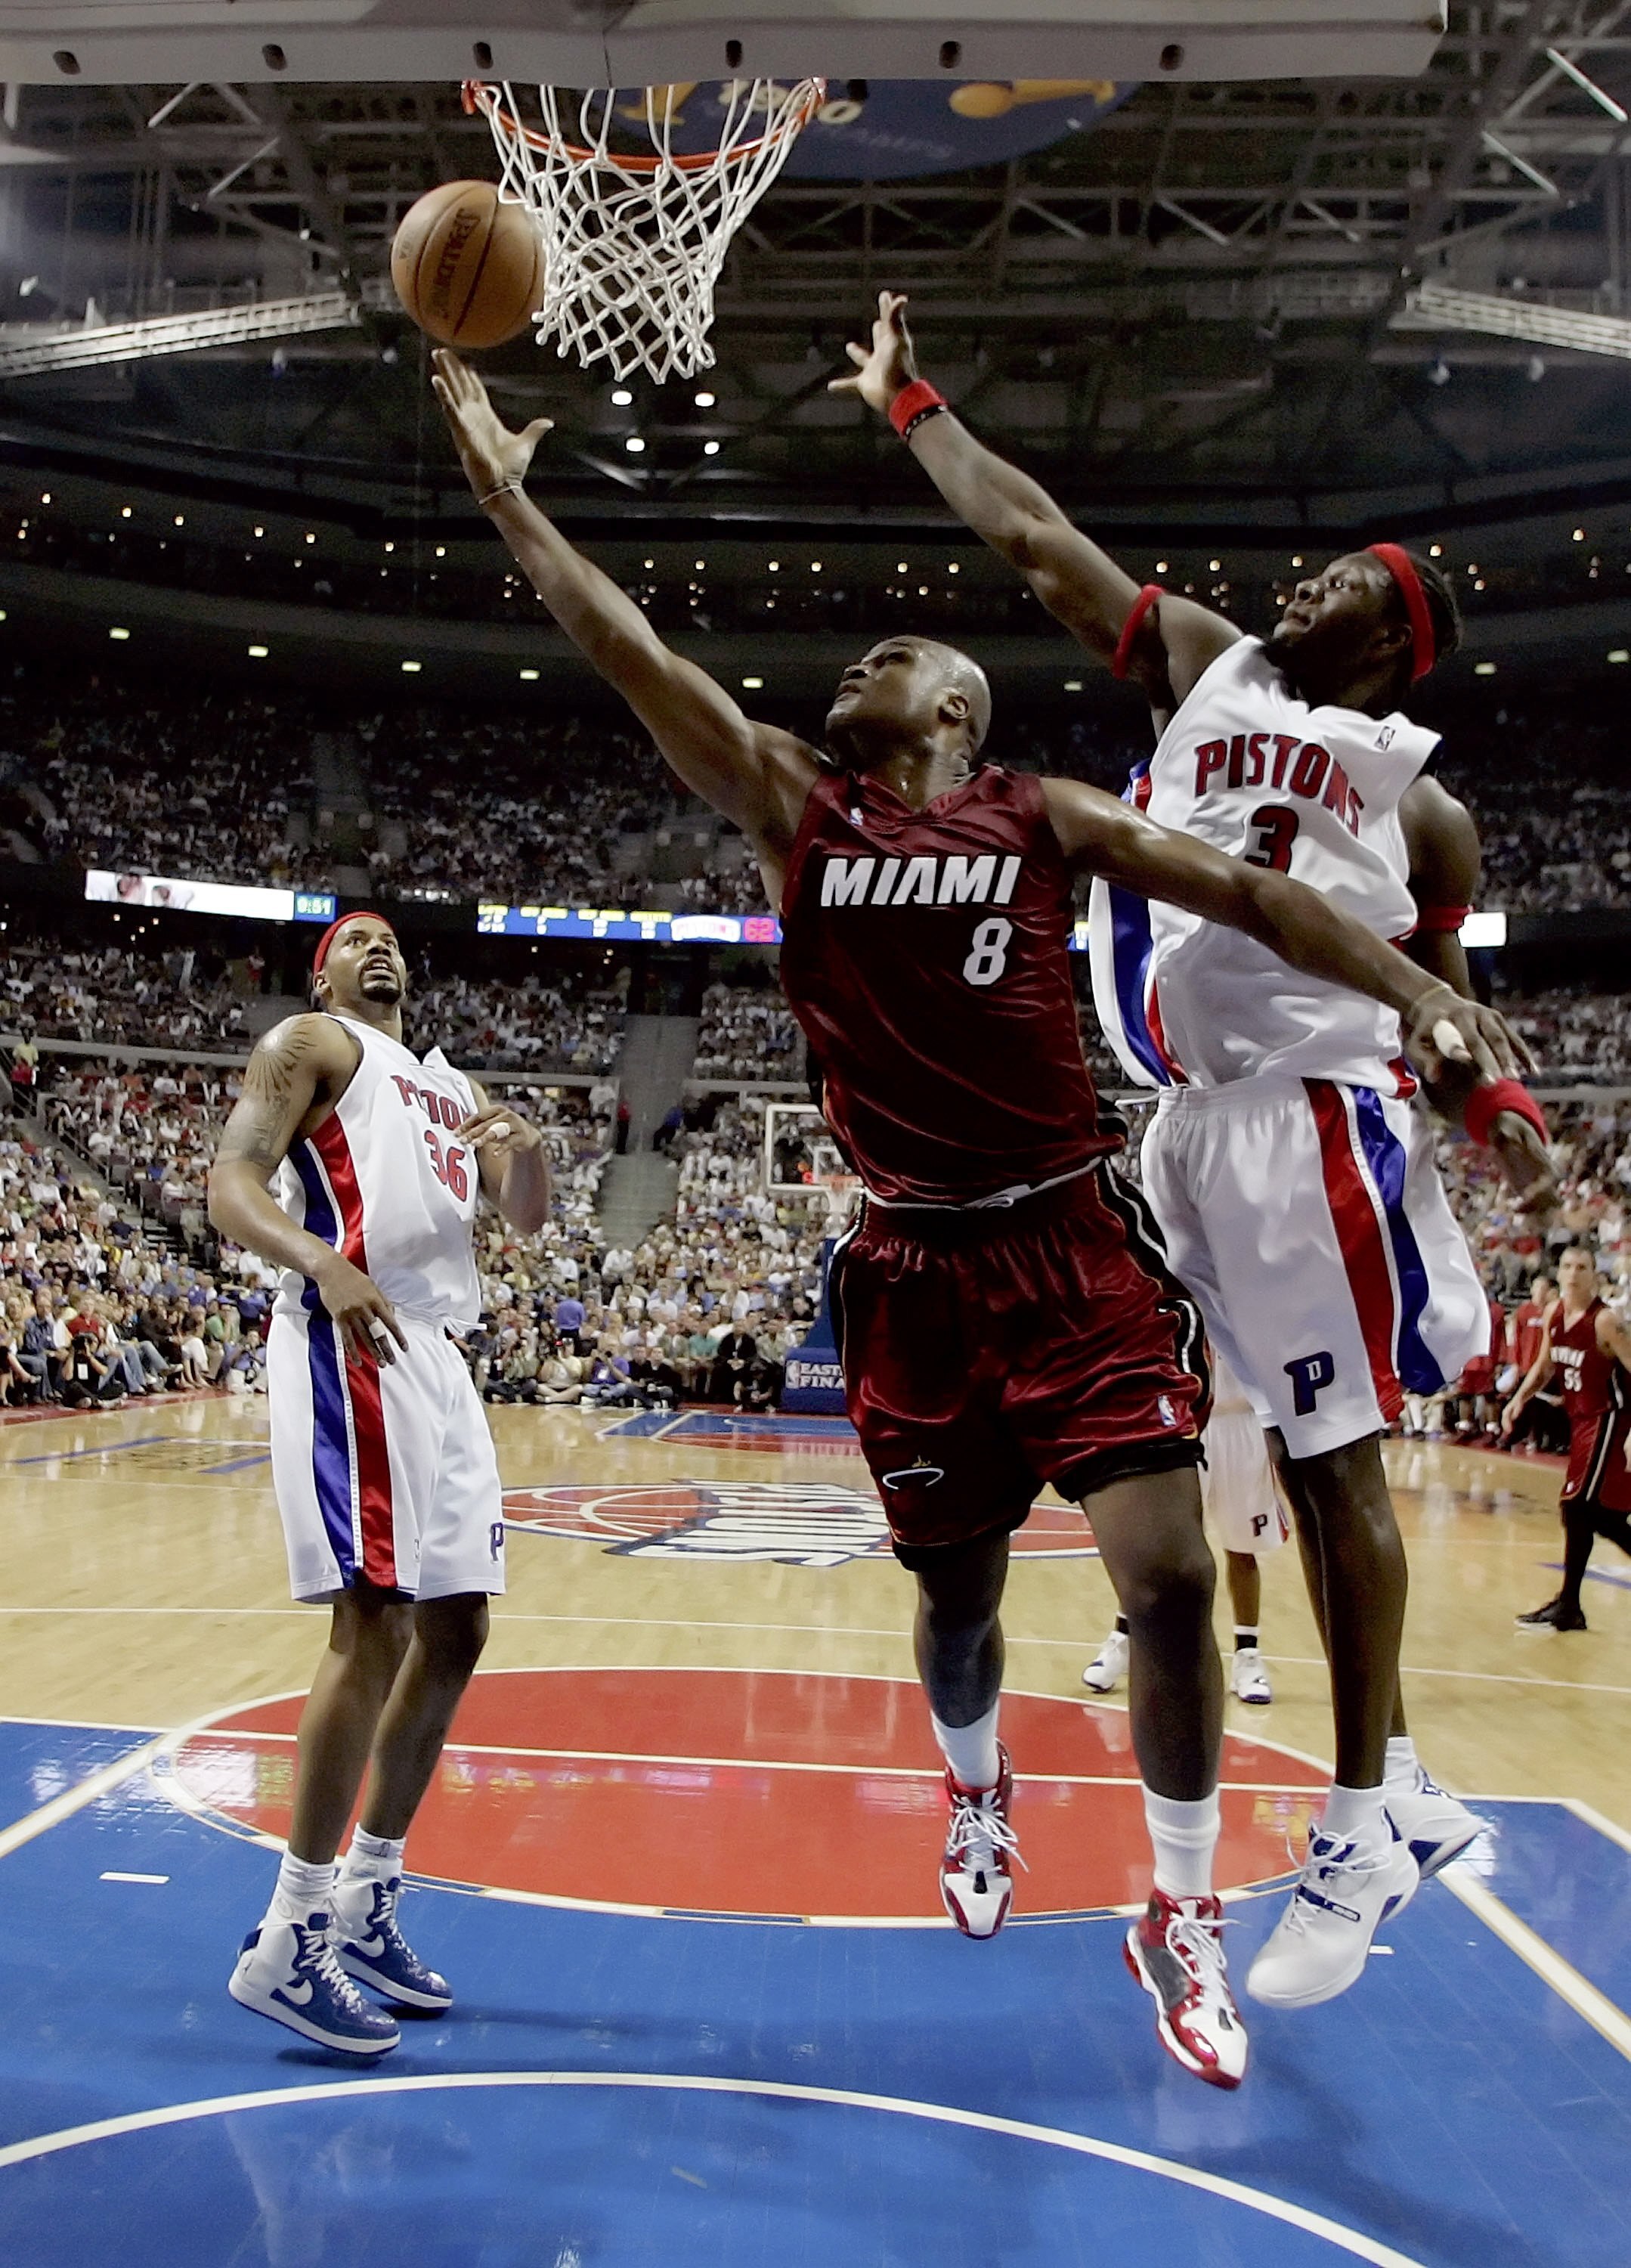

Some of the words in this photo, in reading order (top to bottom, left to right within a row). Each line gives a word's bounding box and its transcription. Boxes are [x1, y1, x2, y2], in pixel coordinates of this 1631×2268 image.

[1194, 733, 1365, 839] PISTONS
[1243, 805, 1300, 875] 3
[821, 855, 1022, 907] MIAMI
[962, 917, 1013, 986] 8
[423, 1129, 468, 1202] 36
[1283, 1351, 1335, 1416] P
